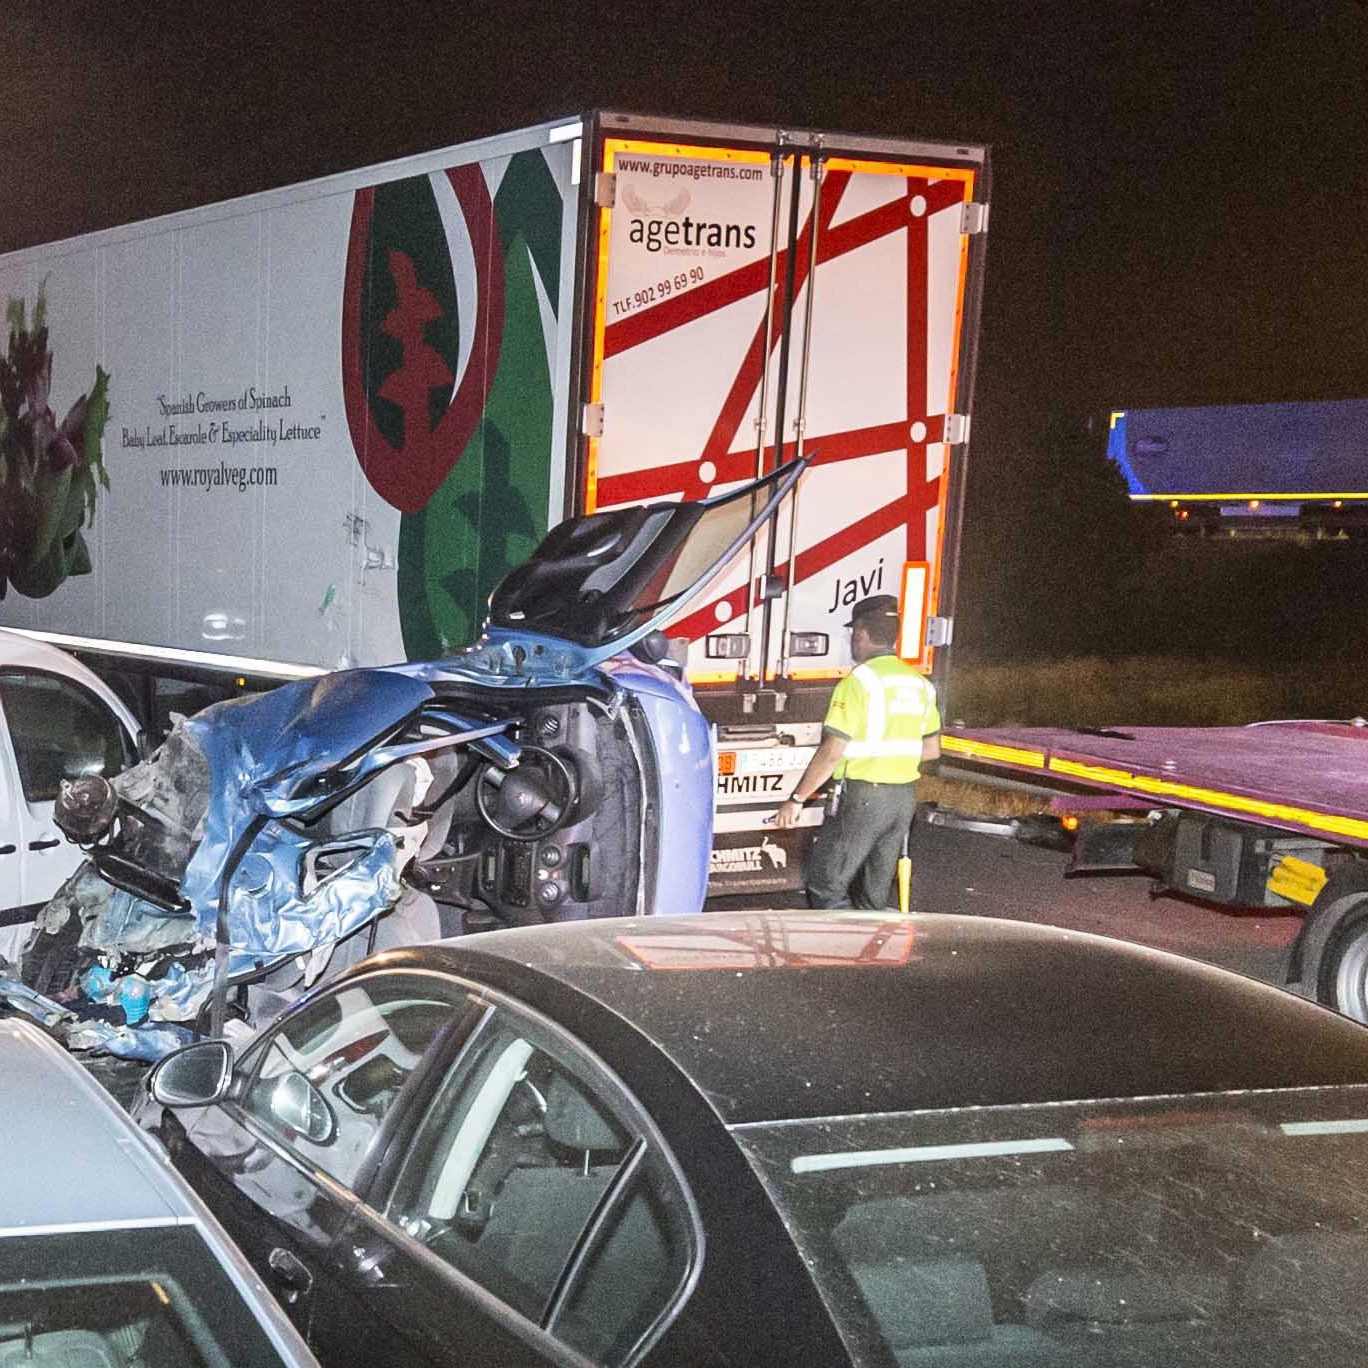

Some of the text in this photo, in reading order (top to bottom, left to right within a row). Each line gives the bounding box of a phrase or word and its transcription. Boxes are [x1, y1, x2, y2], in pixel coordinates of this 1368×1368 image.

[618, 159, 763, 181] www.grupoagetrans.com
[629, 216, 756, 252] agetrans
[657, 279, 672, 298] 99
[674, 273, 688, 290] 69
[690, 266, 704, 284] 90
[196, 391, 237, 413] Growers
[238, 388, 249, 410] of
[249, 385, 292, 413] Spinach
[122, 427, 145, 449] Baby
[169, 423, 208, 446] Escarole
[221, 420, 278, 449] Especiality
[159, 461, 278, 492] www.royalveg.com
[828, 557, 885, 614] Javi
[717, 773, 784, 794] HMITZ
